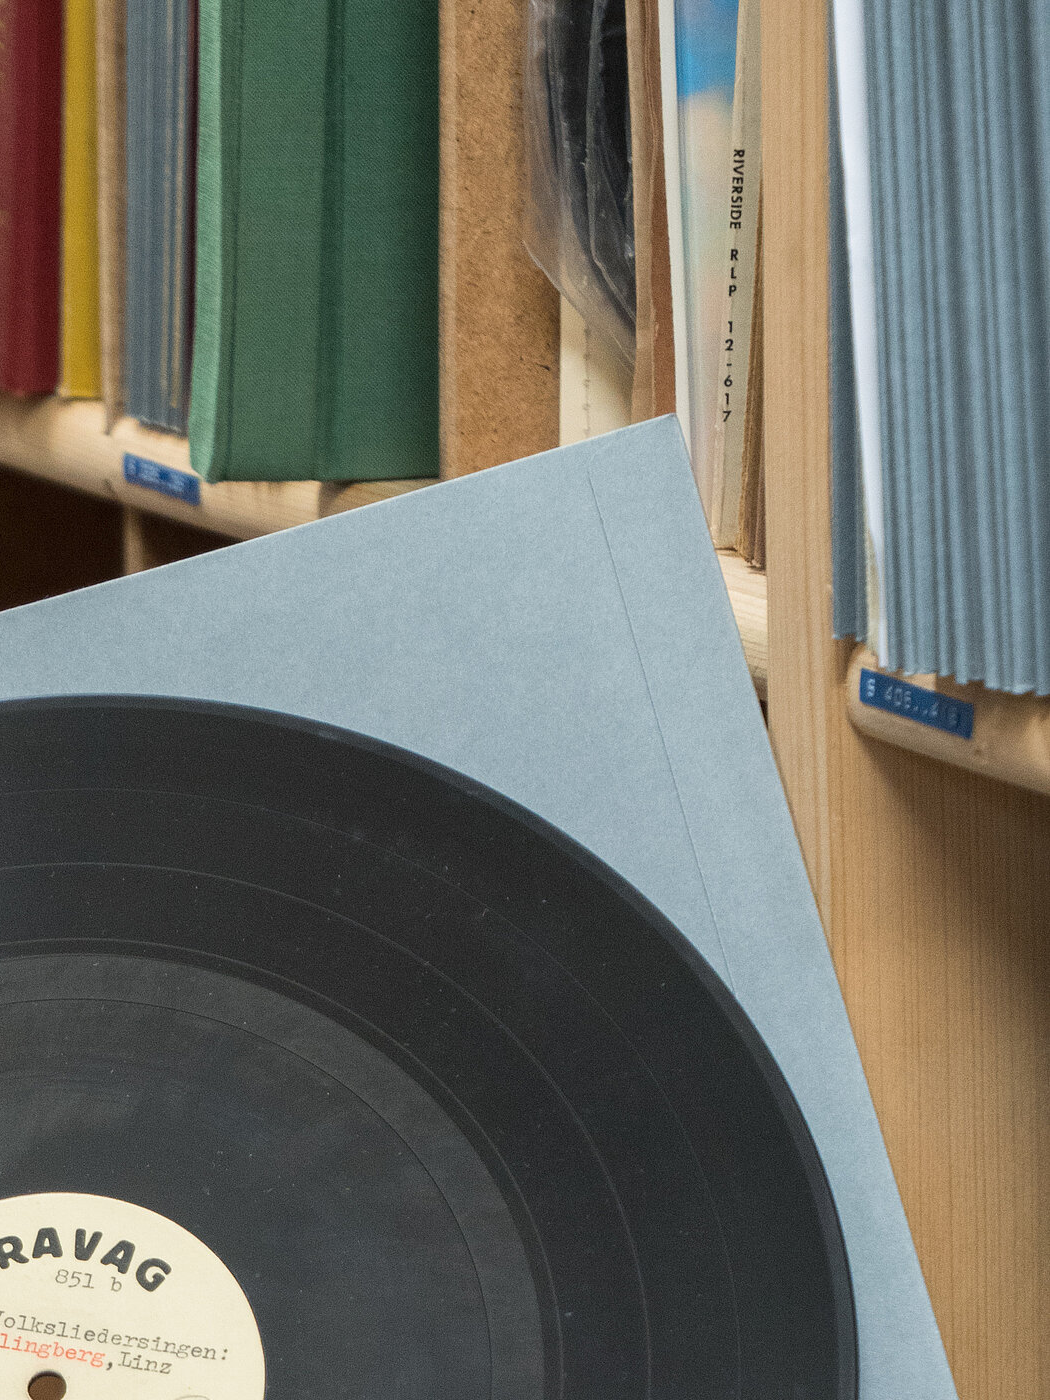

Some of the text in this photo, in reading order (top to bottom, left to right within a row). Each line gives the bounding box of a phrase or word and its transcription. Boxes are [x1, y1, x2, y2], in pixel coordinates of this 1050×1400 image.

[729, 149, 745, 230] RIVERSIDE
[722, 320, 735, 423] 12-617
[54, 1268, 123, 1293] 851 b
